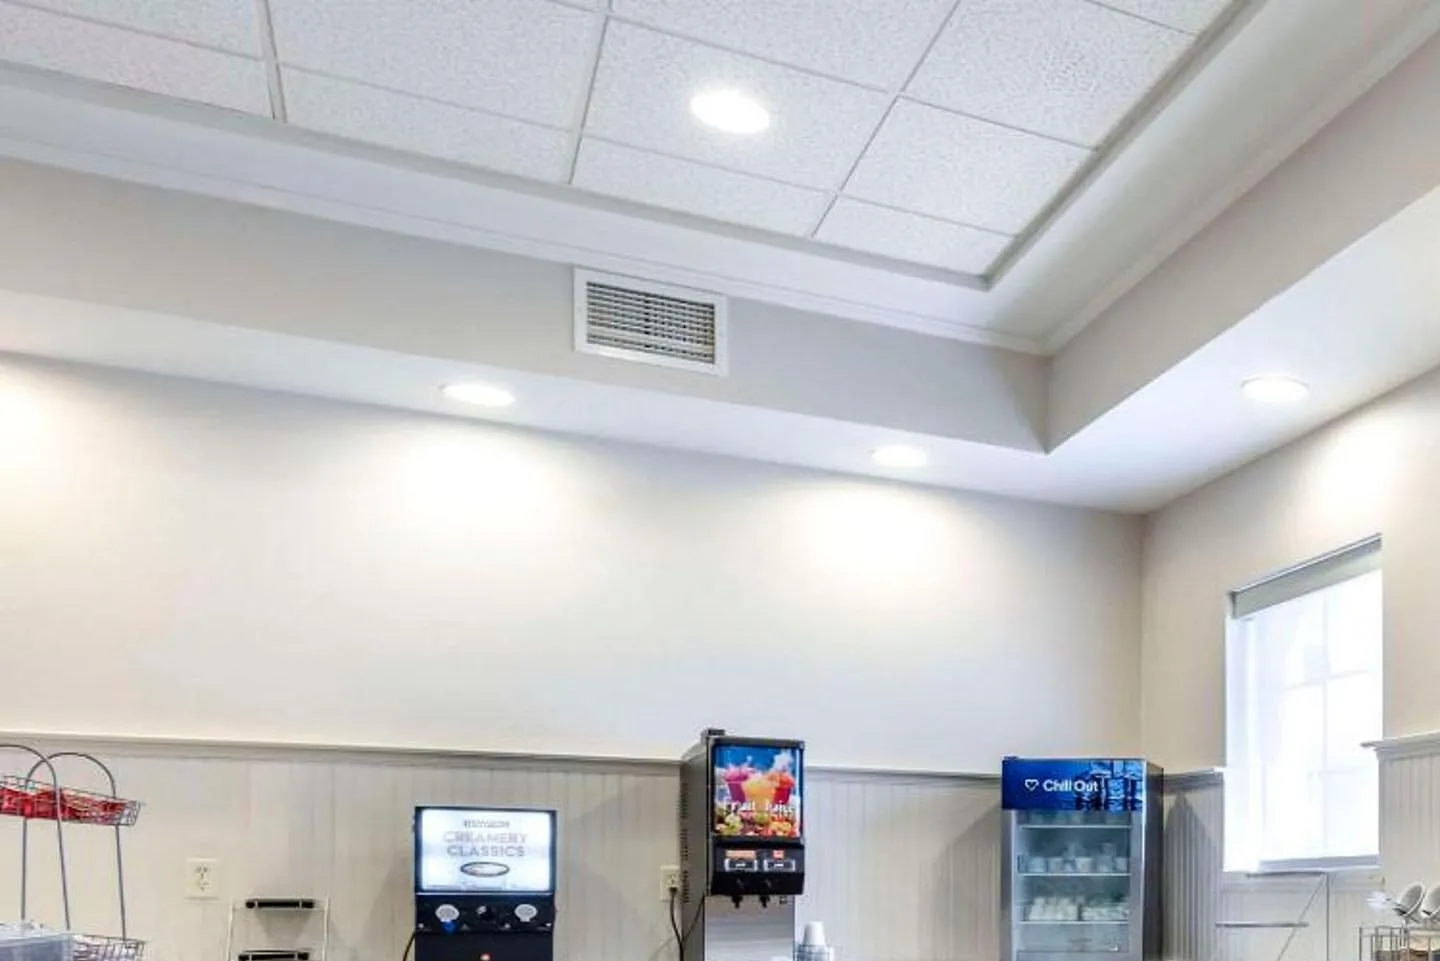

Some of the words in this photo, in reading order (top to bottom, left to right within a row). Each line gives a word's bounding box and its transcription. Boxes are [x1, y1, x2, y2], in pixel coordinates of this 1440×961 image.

[1044, 779, 1072, 791] Chill
[1075, 779, 1098, 792] Out
[444, 832, 528, 843] CREAMERY
[446, 845, 525, 857] CLASSICS
